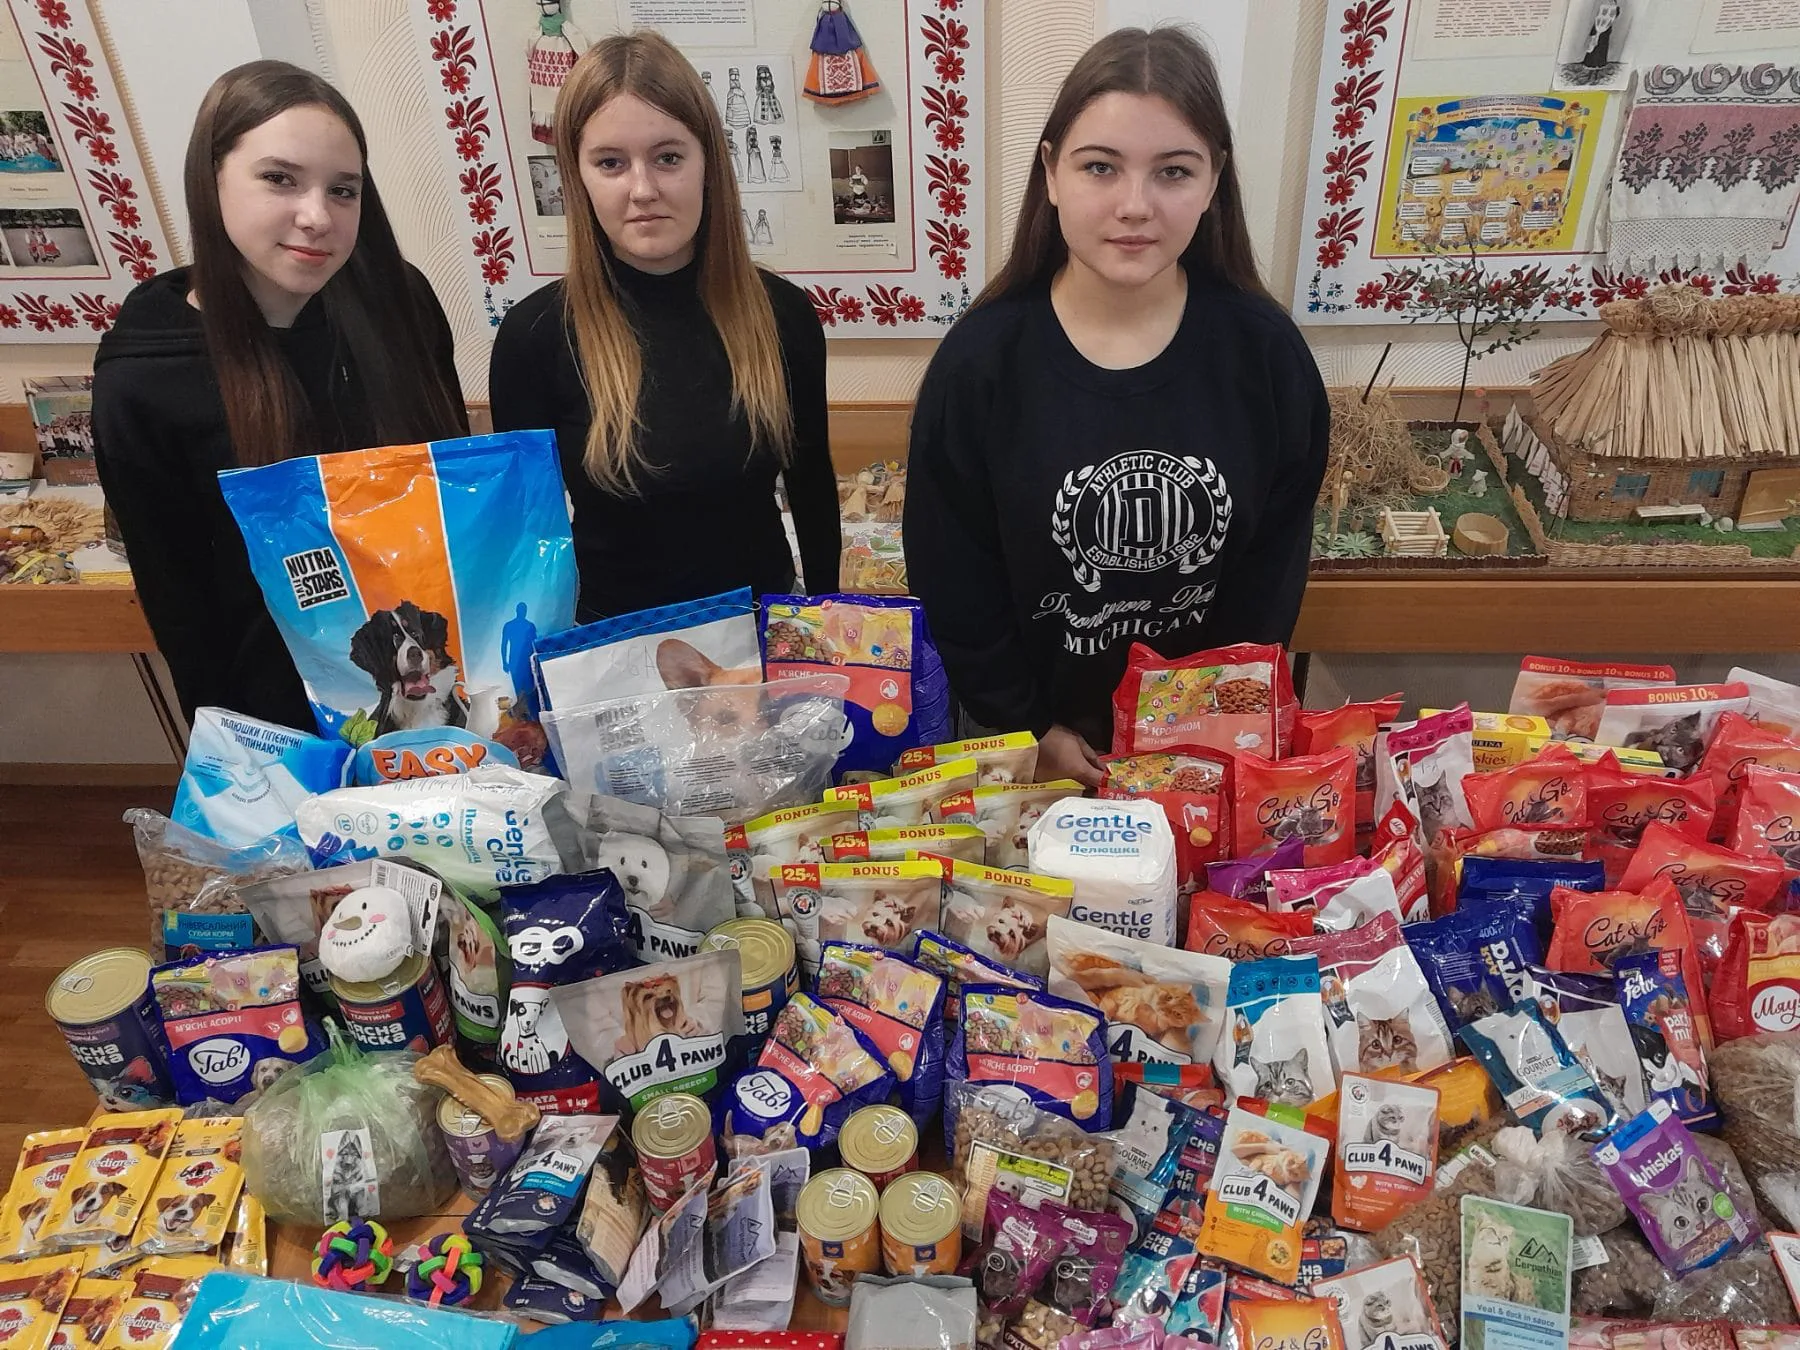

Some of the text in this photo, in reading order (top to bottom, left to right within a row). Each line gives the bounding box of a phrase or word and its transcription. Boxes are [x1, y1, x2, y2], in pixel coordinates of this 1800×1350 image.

[1090, 455, 1196, 496] ATHLETIC CLUB
[1120, 487, 1164, 549] D
[288, 549, 338, 578] NUTRA
[1086, 533, 1204, 570] ESTABLISHED 1982
[293, 569, 345, 599] FIVE STARS
[1063, 608, 1209, 656] MICHIGAN
[1529, 662, 1556, 673] BONUS
[1625, 670, 1651, 679] BONUS
[1648, 687, 1718, 703] BONUS 10%
[371, 743, 488, 780] EASY
[903, 739, 1006, 764] 25% BONUS
[900, 769, 942, 788] BONUS
[1003, 783, 1047, 792] BONUS
[1539, 776, 1572, 803] Go
[774, 805, 820, 825] BONUS
[1257, 797, 1293, 825] Cat
[1310, 783, 1341, 813] Go
[1603, 803, 1643, 827] Cat
[1657, 798, 1690, 825] Go
[1056, 813, 1153, 834] Gentle
[1074, 830, 1137, 844] care
[834, 827, 946, 848] 25% BONUS
[1069, 844, 1140, 855] Пелюшки
[783, 865, 901, 882] 25% BONUS
[984, 871, 1032, 887] BONUS
[1654, 863, 1693, 886] Cat
[1709, 878, 1747, 903] Go
[1071, 905, 1153, 926] Gentle
[212, 930, 234, 938] КОРМ
[1584, 916, 1628, 949] Cat
[1204, 933, 1246, 960] Cat
[306, 968, 330, 987] CLU
[1489, 941, 1524, 1004] руга
[455, 991, 495, 1020] PAWS
[209, 1015, 242, 1028] АСОРТІ
[193, 1044, 246, 1075] Гав!
[1109, 1029, 1133, 1063] 4
[612, 1038, 724, 1090] CLUB 4 PAWS
[1516, 1055, 1557, 1077] GOURMET
[740, 1075, 791, 1111] Гав!
[87, 1156, 139, 1170] Pedigree
[552, 1159, 577, 1175] PAWS
[1348, 1143, 1423, 1177] CLUB 4 PAWS
[1630, 1142, 1684, 1188] whiskas
[1222, 1178, 1296, 1220] CLUB 4 PAWS
[118, 1313, 171, 1332] Pedigree
[1477, 1303, 1496, 1314] Veal
[1505, 1309, 1522, 1321] duck
[1524, 1312, 1531, 1322] in
[1532, 1316, 1556, 1328] sauce
